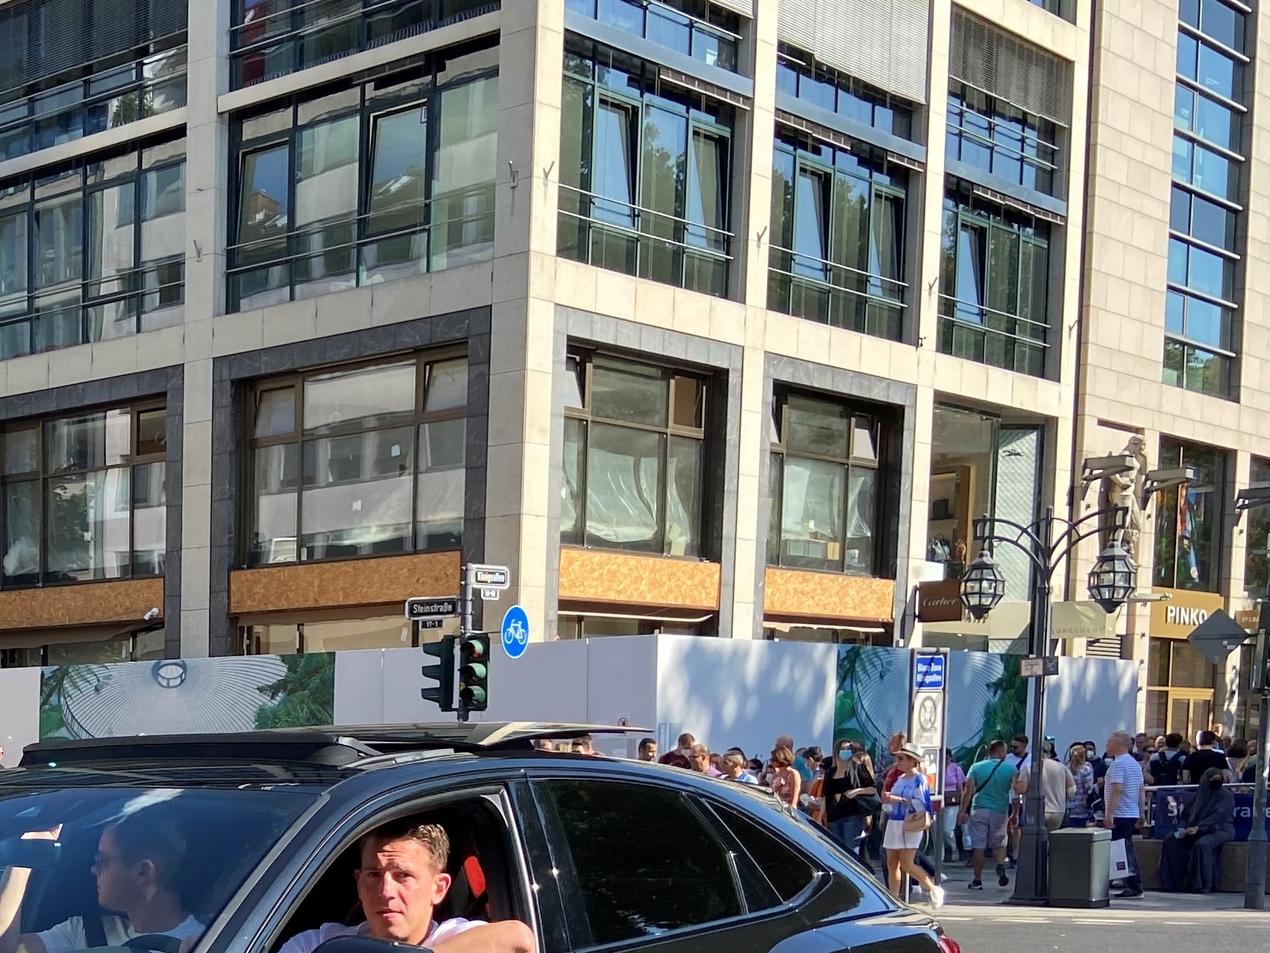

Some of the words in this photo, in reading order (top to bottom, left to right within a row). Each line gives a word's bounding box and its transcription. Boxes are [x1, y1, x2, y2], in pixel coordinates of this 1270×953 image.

[922, 596, 958, 607] Cartier
[413, 602, 452, 614] Steinstraße
[1166, 605, 1208, 626] PINKO
